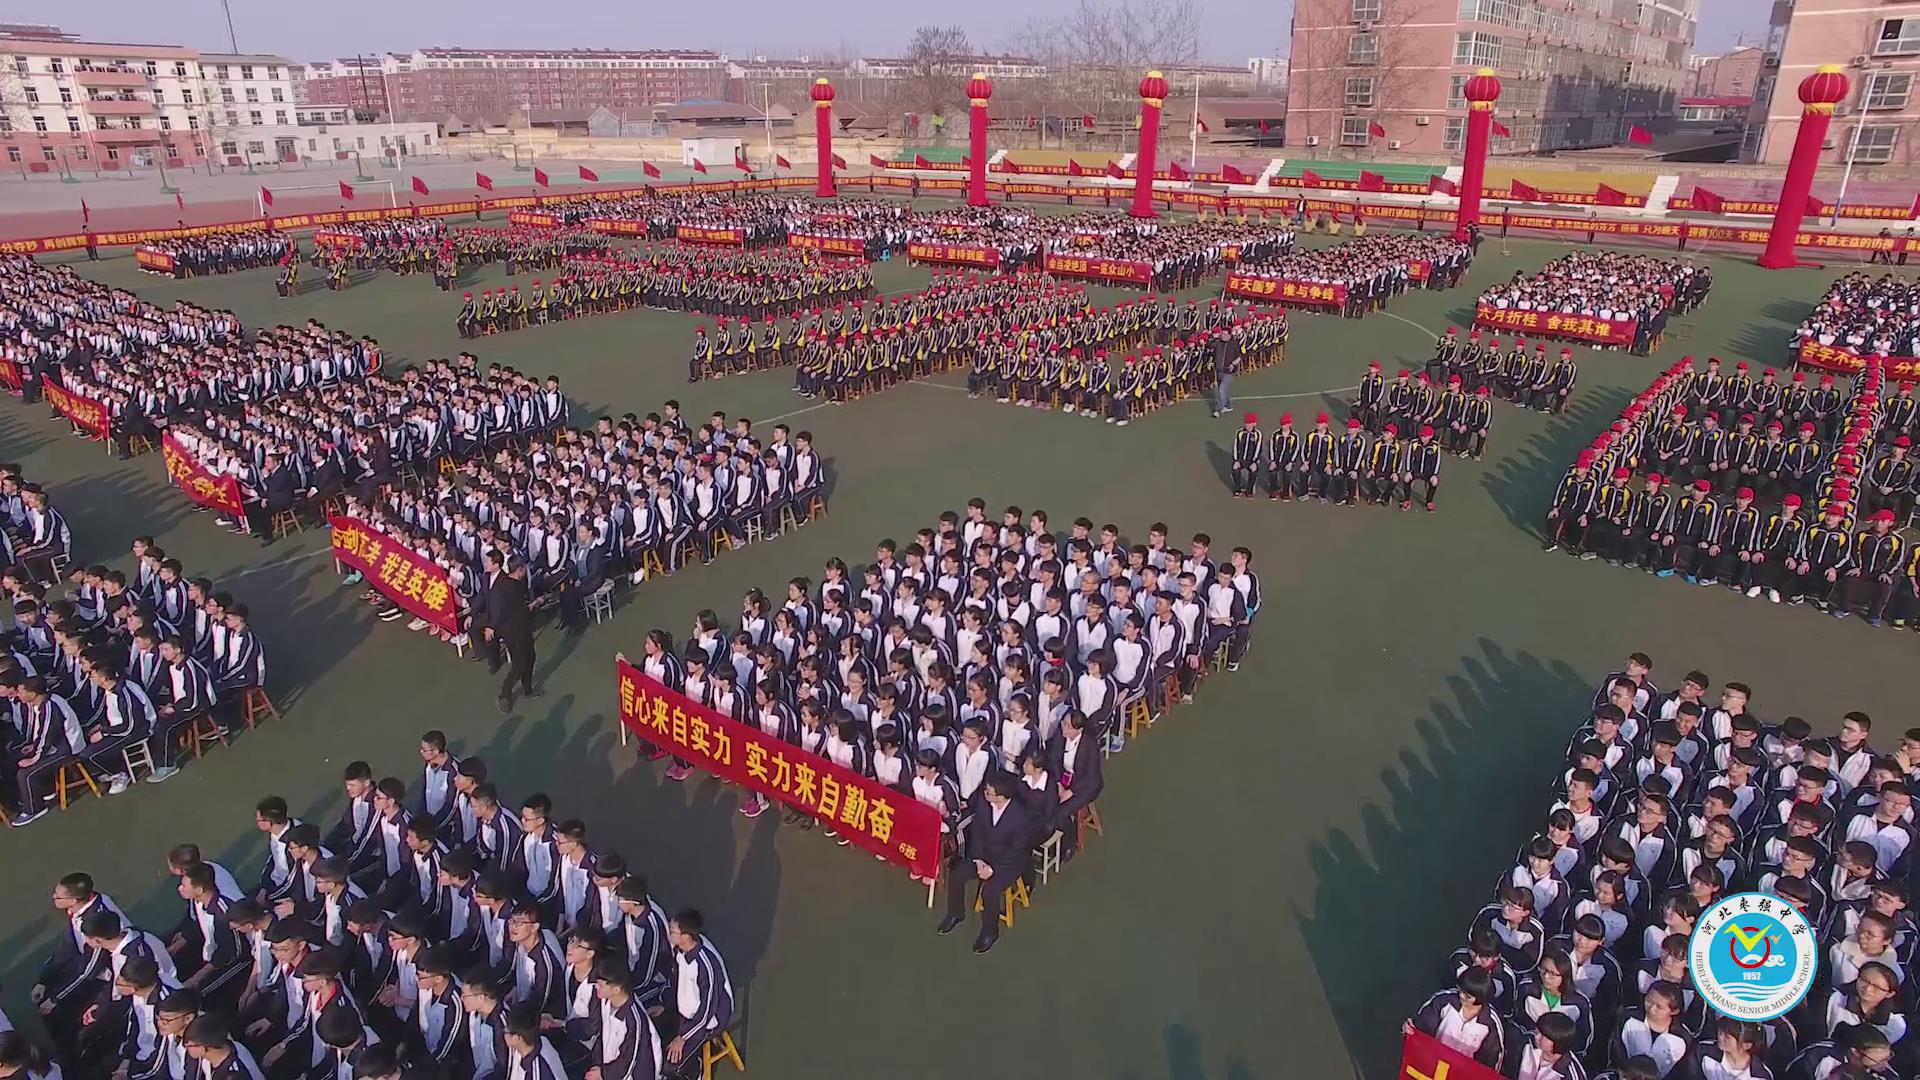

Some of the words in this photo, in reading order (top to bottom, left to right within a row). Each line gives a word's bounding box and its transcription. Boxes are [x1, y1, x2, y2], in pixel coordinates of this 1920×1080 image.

[1091, 263, 1135, 279] 一览众山小
[1477, 307, 1539, 327] 六月折桂
[1546, 315, 1612, 337] 舍我其谁
[378, 552, 449, 612] 我是英雄
[620, 675, 732, 766] 信心来自实力
[745, 741, 895, 844] 实力来自勤奋
